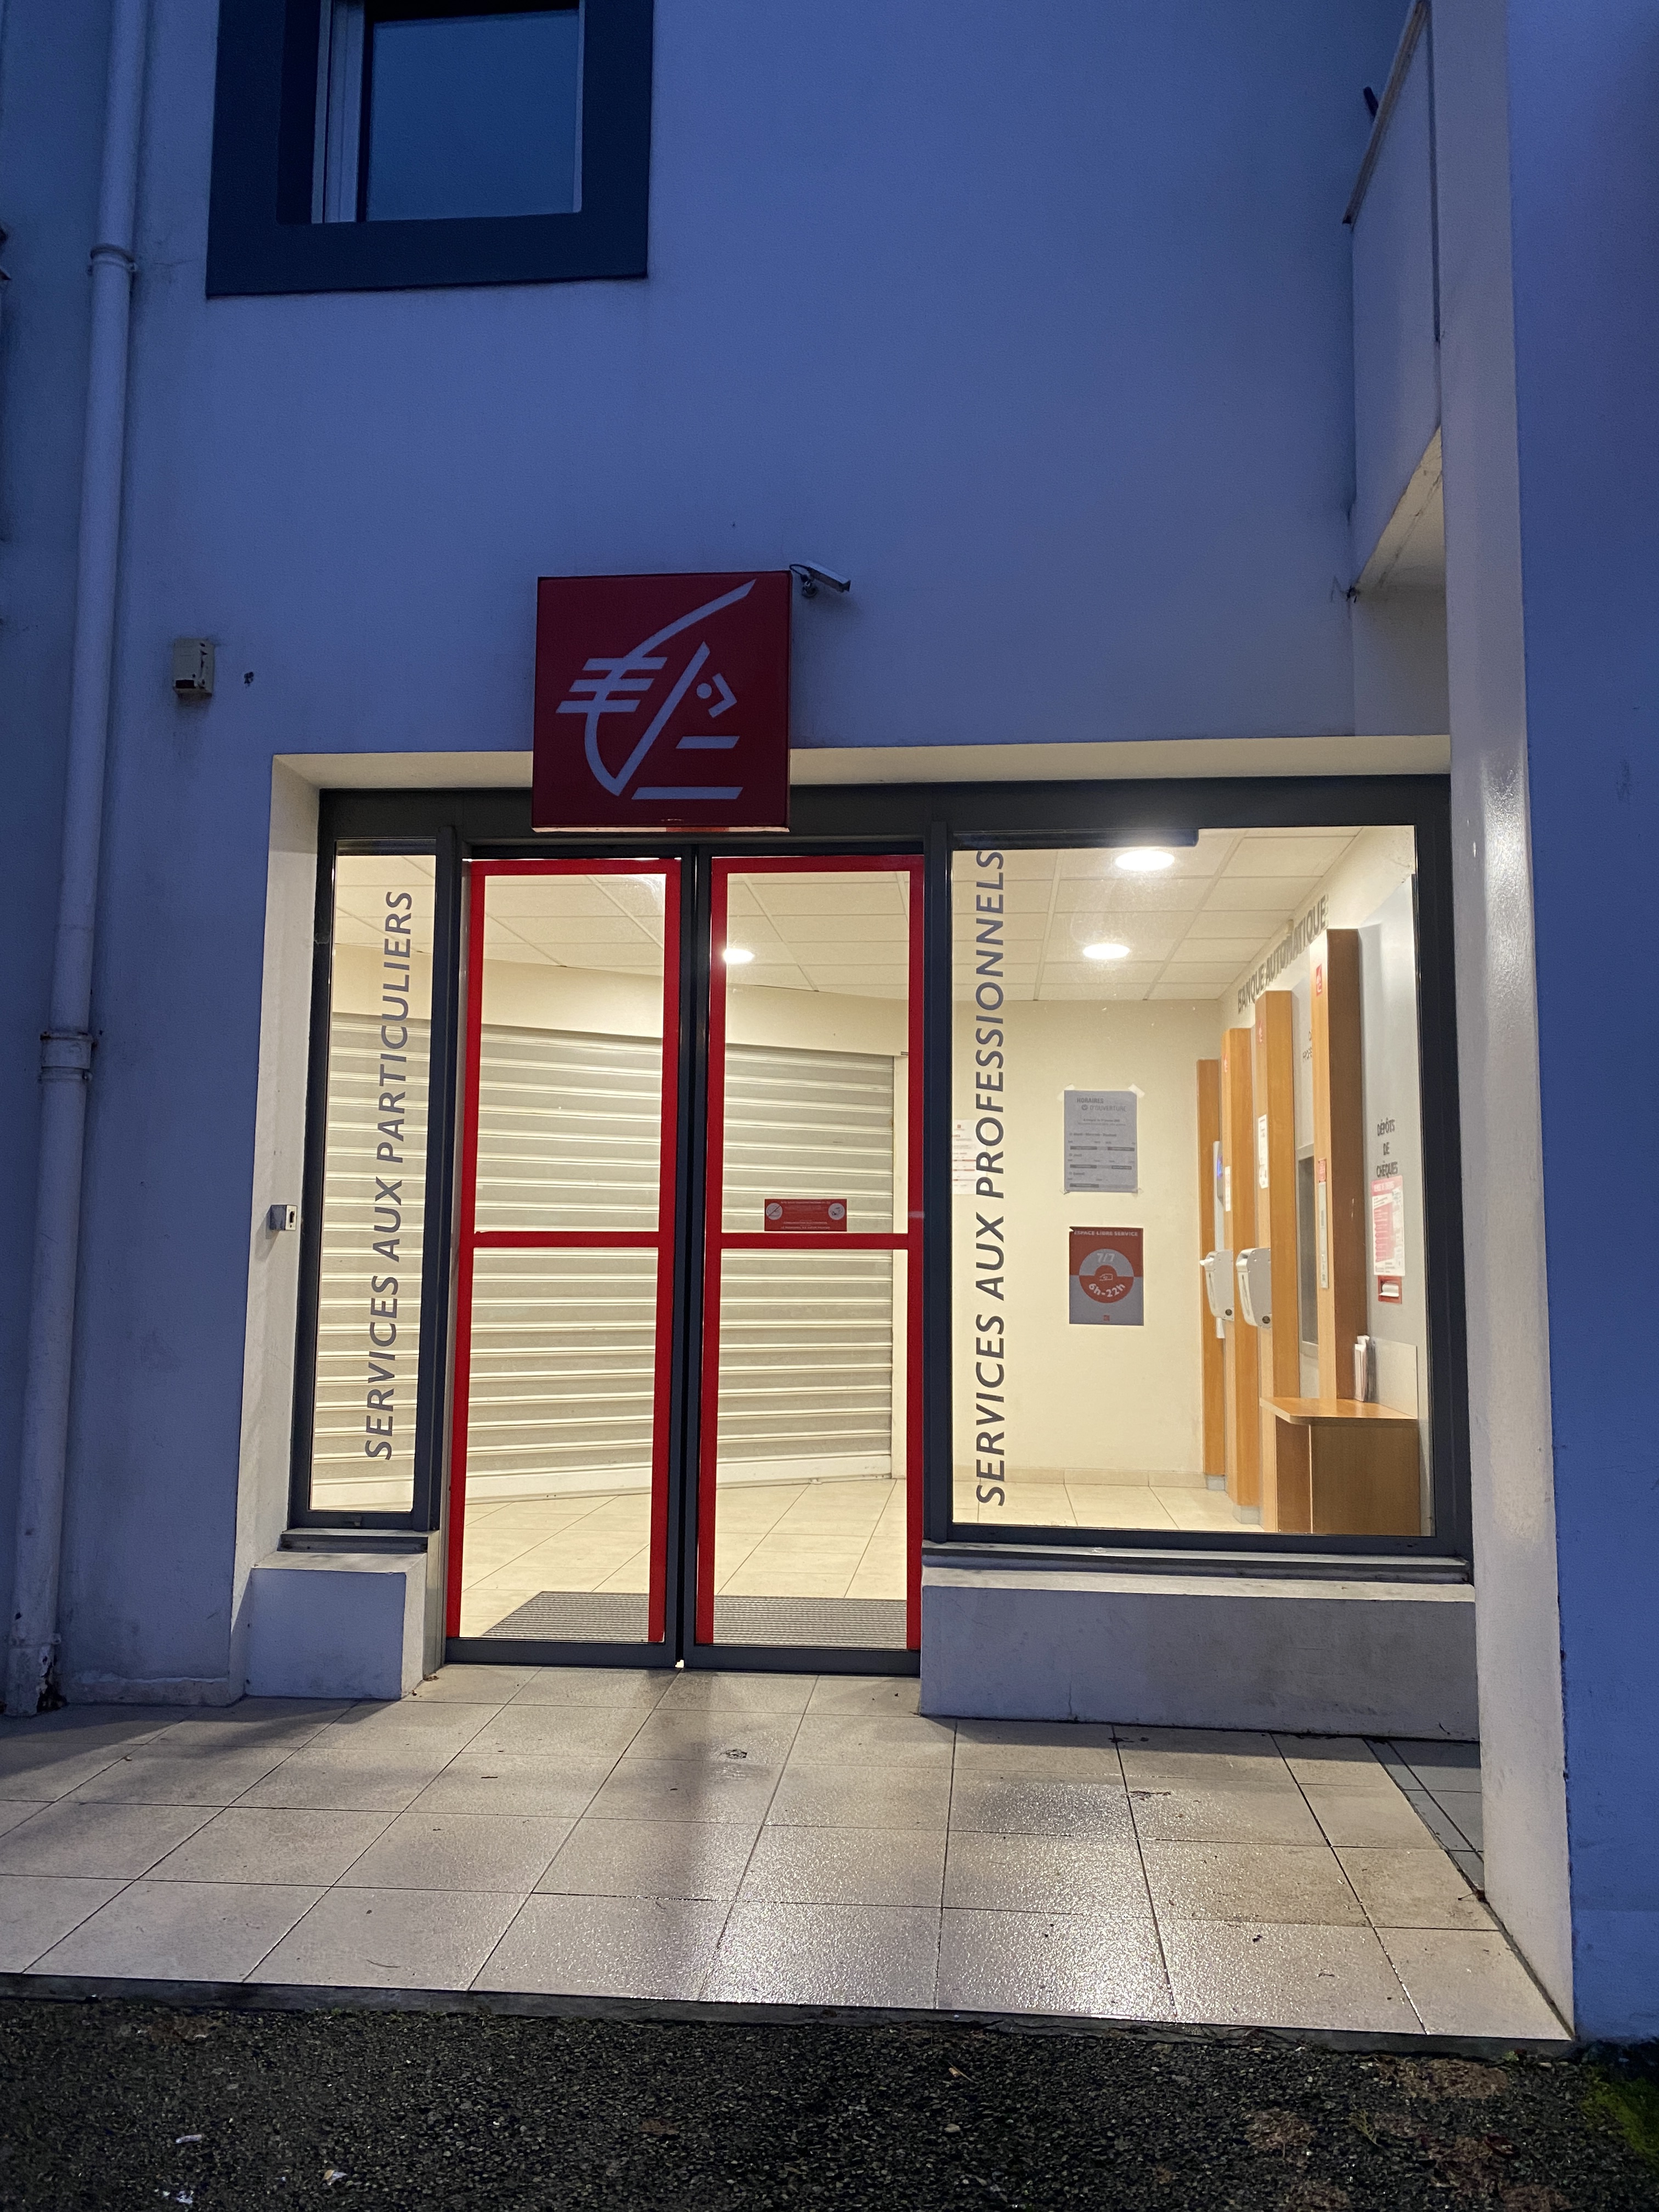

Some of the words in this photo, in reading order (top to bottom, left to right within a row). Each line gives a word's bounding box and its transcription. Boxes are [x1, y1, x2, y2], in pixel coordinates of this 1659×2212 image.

[1238, 963, 1266, 1014] BANQUE
[1266, 894, 1328, 986] AUTOMATIQUE
[376, 891, 413, 1164] PARTICULIERS
[975, 850, 1005, 1199] PROFESSIONNELS
[1383, 1142, 1390, 1155] DE
[373, 1176, 403, 1262] AUX
[975, 1212, 1005, 1301] AUX
[1097, 1252, 1115, 1262] 7/7
[365, 1276, 399, 1460] SERVICES
[975, 1314, 1005, 1506] SERVICES
